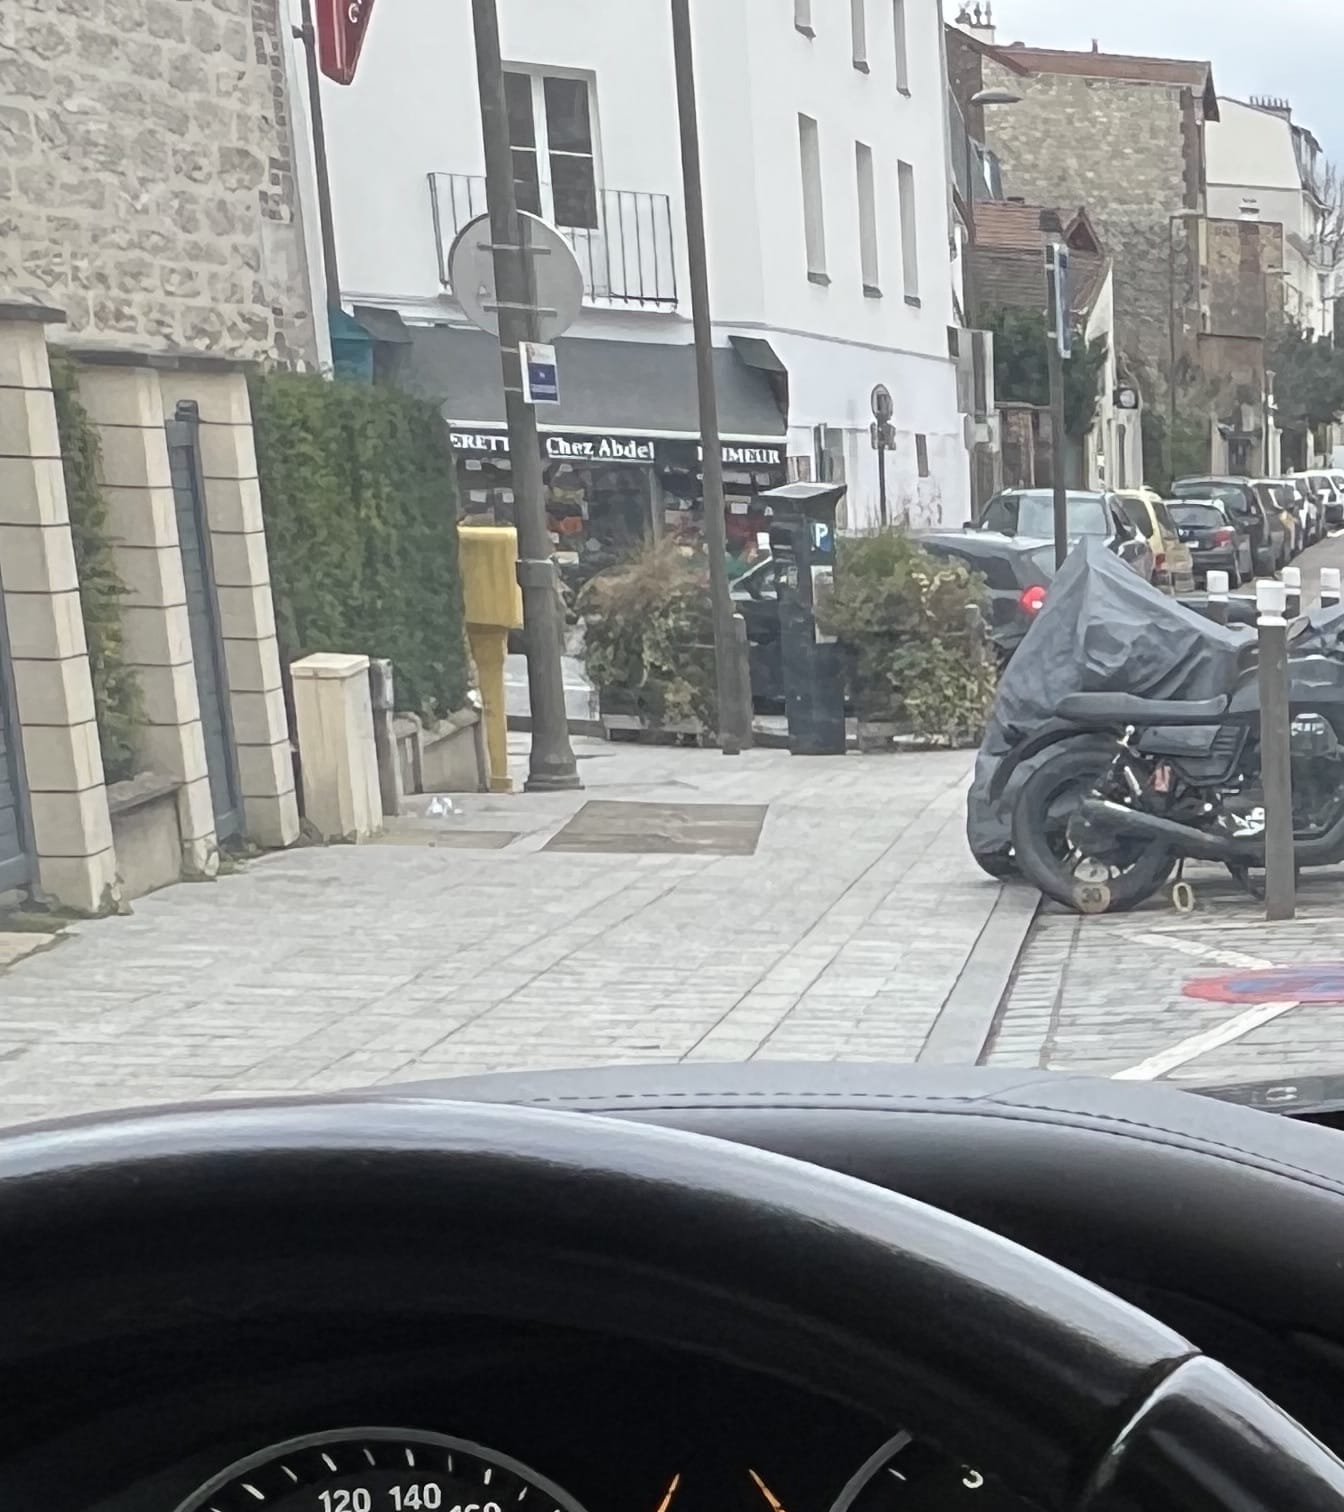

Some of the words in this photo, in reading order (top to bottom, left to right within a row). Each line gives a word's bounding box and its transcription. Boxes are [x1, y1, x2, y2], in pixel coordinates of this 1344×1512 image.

[450, 432, 510, 452] ERETT
[546, 437, 594, 456] Chez
[599, 438, 655, 460] Abdel
[697, 446, 780, 464] IMEUR
[815, 522, 829, 548] P
[388, 1482, 442, 1511] 140
